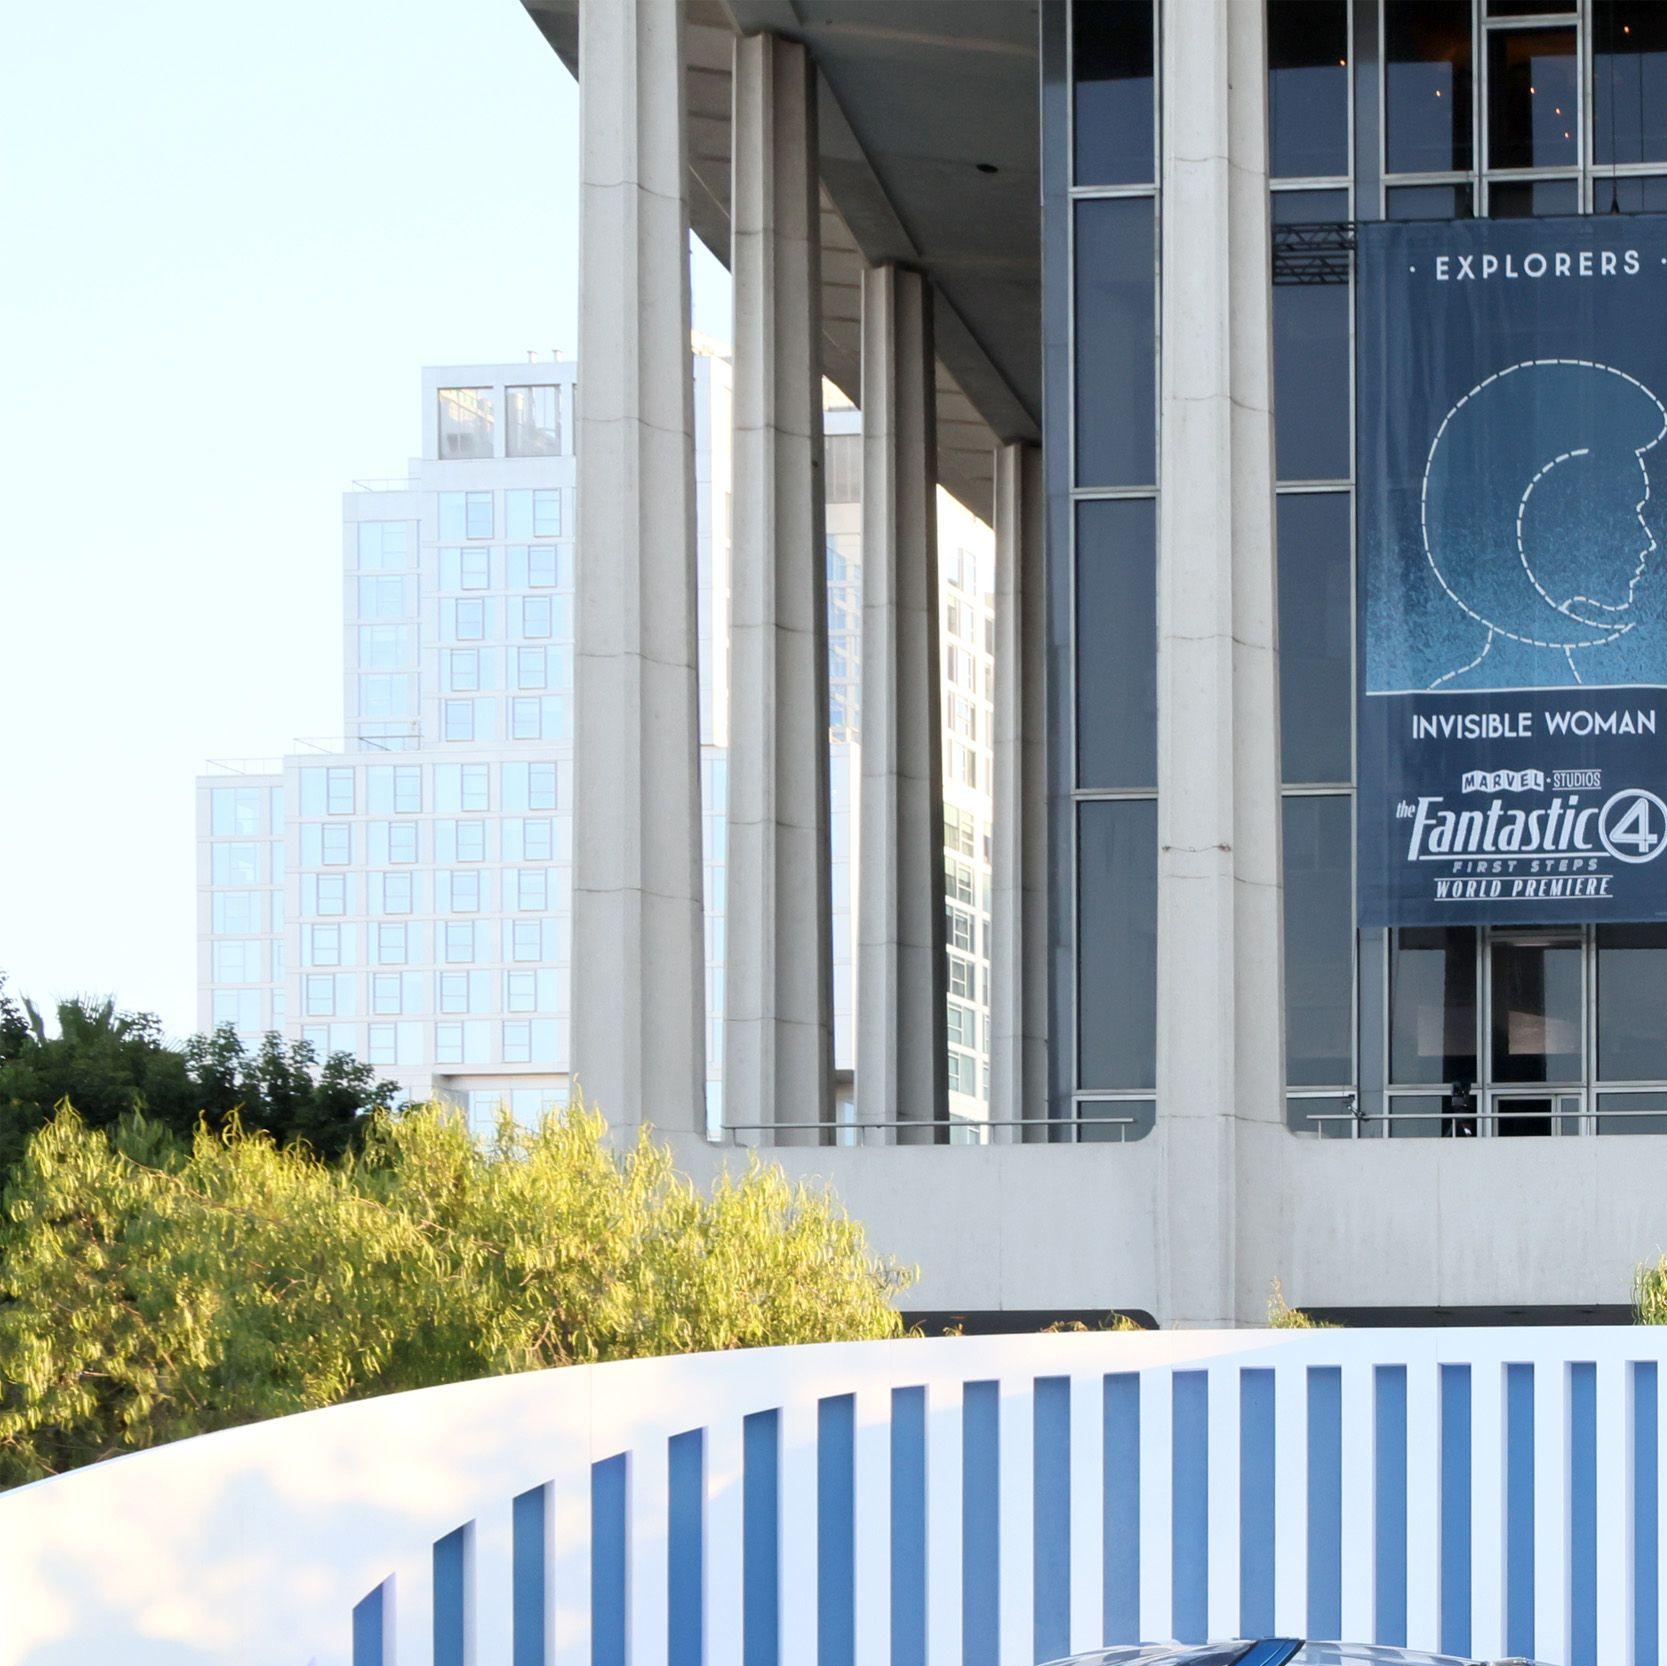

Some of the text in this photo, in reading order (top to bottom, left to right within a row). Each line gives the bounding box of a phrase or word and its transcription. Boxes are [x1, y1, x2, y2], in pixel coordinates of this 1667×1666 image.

[1437, 250, 1639, 280] EXPLORERS
[1413, 710, 1655, 738] INVISIBLE WOMAN
[1462, 770, 1600, 793] MARVEL STUDIOS
[1397, 800, 1415, 818] the
[1408, 795, 1599, 861] Fantastic
[1453, 858, 1598, 873] FIRST STEPS
[1436, 877, 1610, 898] WORLD PREMIERE
